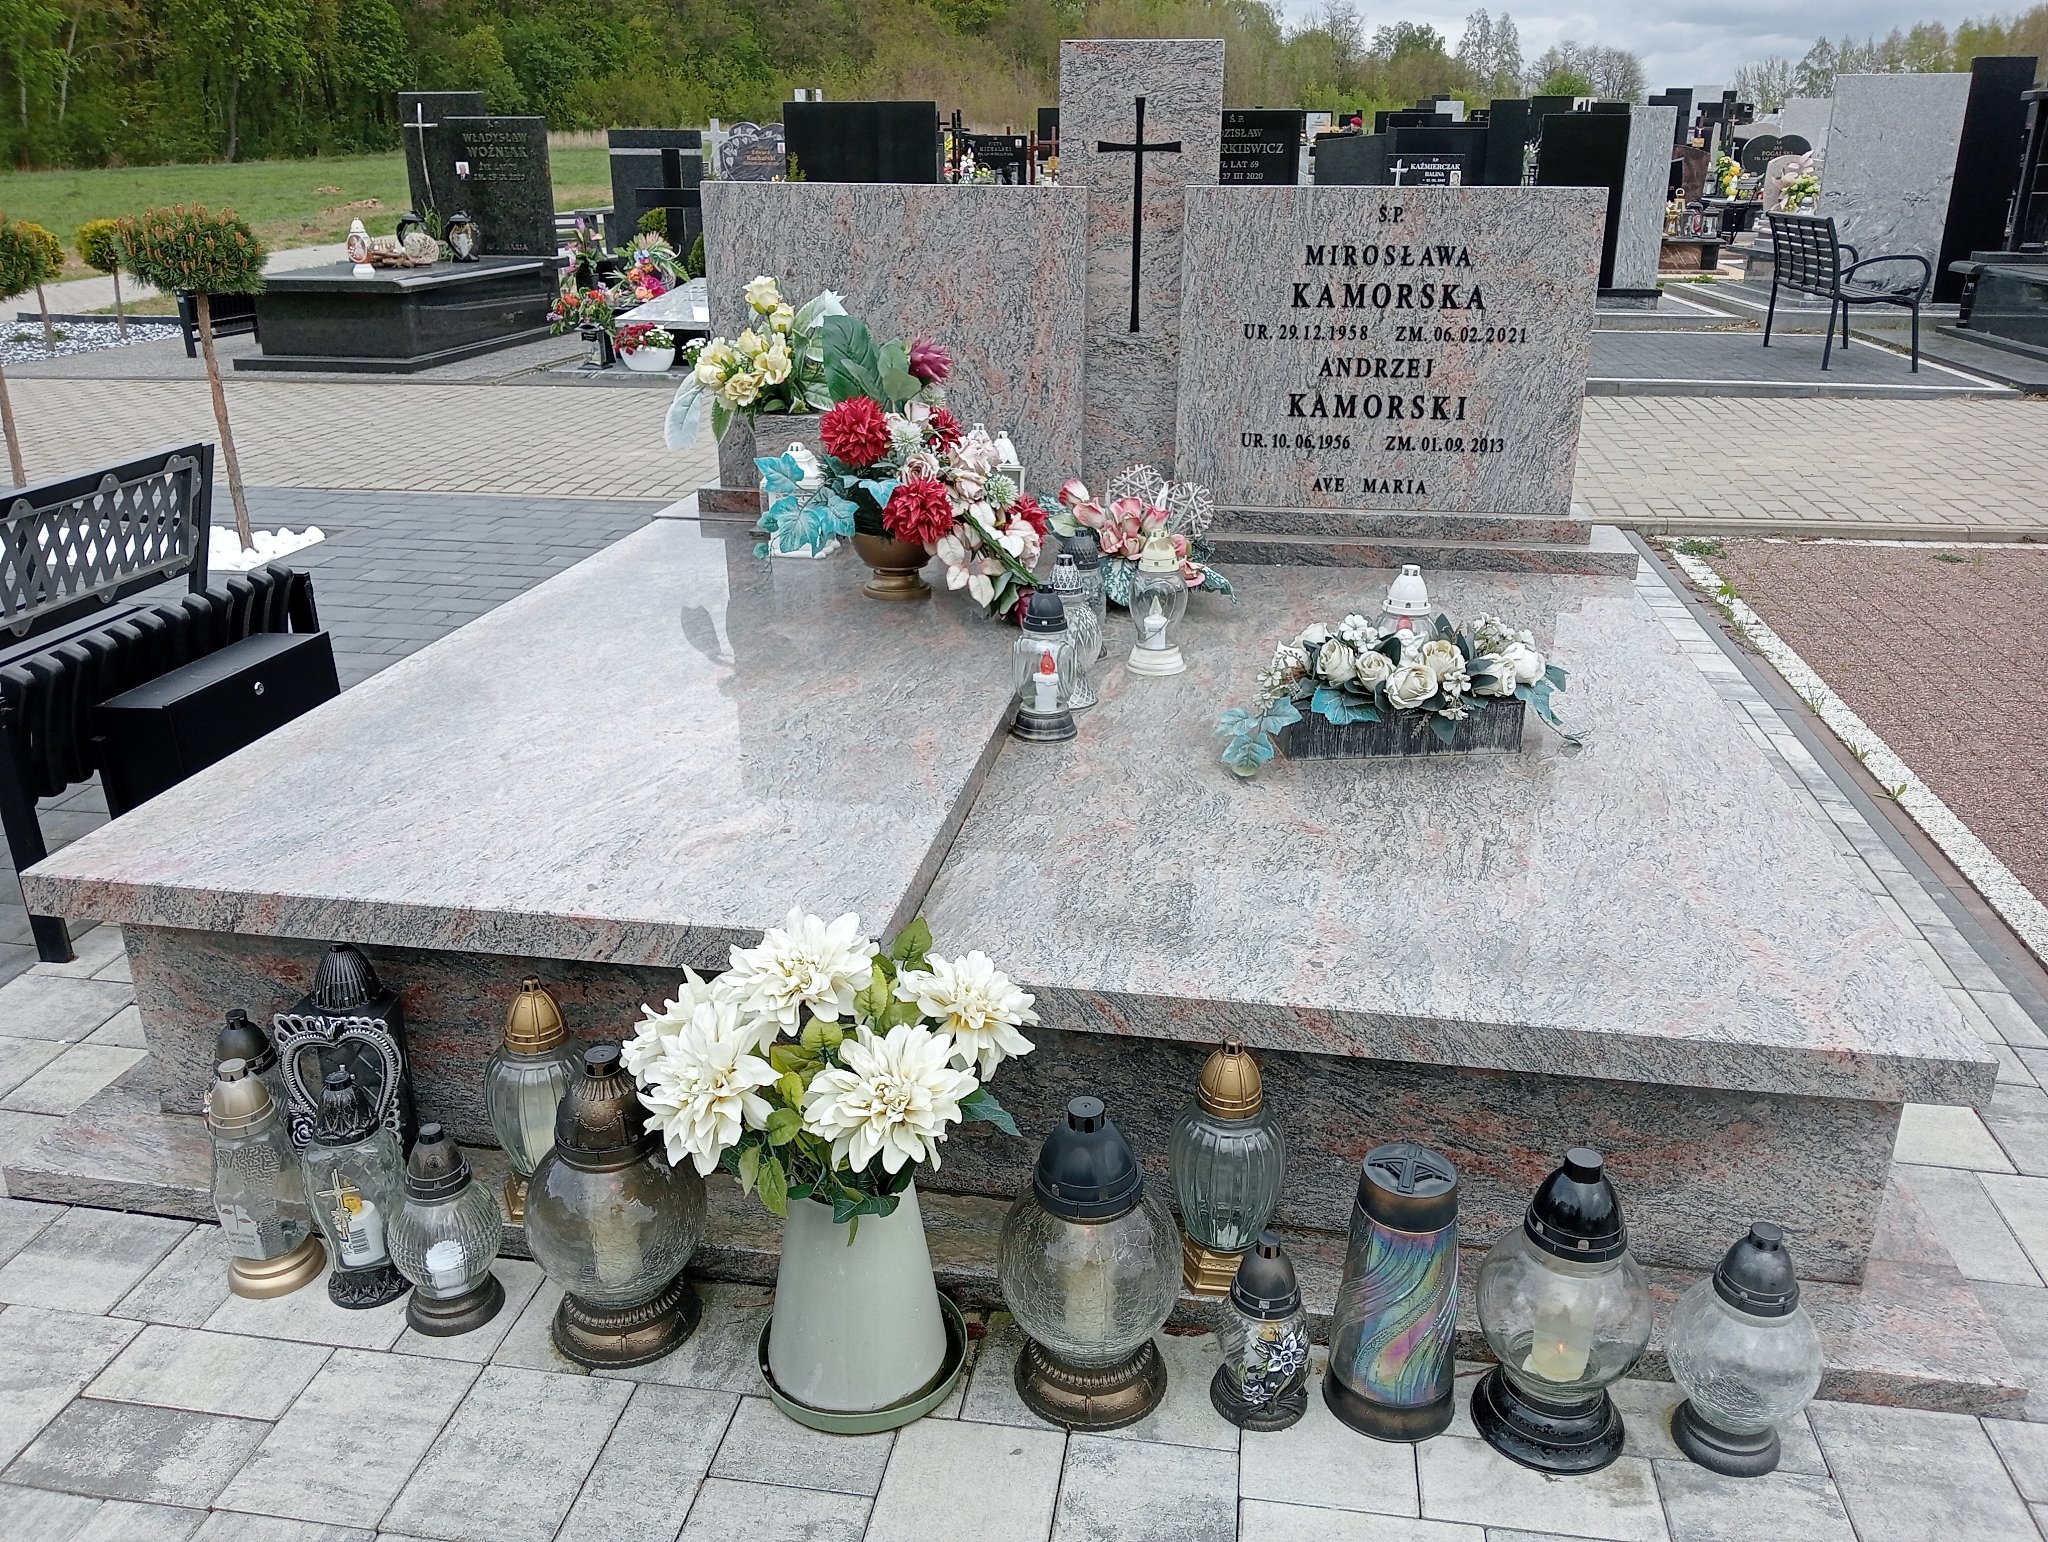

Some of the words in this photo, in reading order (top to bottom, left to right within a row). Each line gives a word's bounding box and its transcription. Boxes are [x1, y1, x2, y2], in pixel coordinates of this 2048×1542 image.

[466, 144, 528, 158] WOŹNIAK
[1230, 160, 1248, 168] LAT
[1249, 160, 1260, 168] 69
[1222, 172, 1231, 180] 27
[1232, 172, 1244, 180] III
[1246, 172, 1264, 180] 2020
[1305, 244, 1472, 267] MIROSŁAWA
[1290, 282, 1486, 310] KAMORSKA
[1243, 323, 1273, 340] UR.
[1394, 326, 1428, 343] ZM.
[1318, 357, 1435, 379] ANDRZEJ
[1288, 393, 1468, 421] KAMORSKI
[1240, 432, 1268, 449] UR.
[1384, 435, 1416, 451] ZM.
[1311, 477, 1345, 493] AVE
[1362, 478, 1428, 495] MARIA
